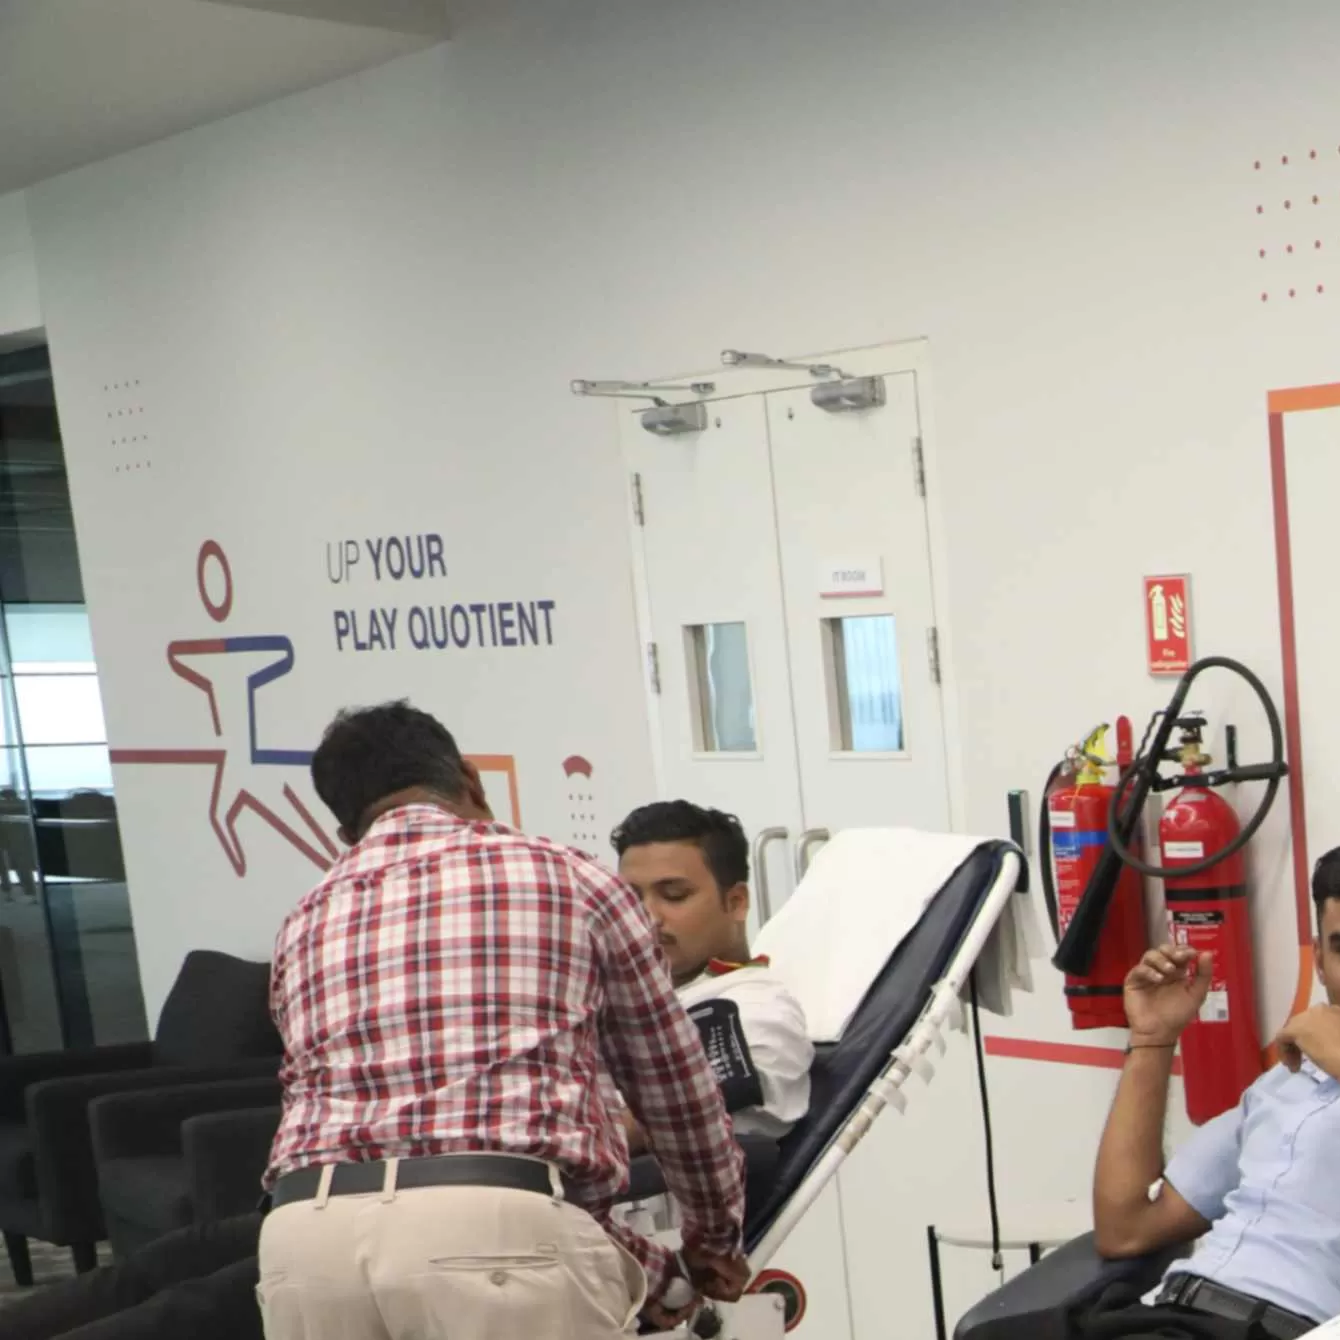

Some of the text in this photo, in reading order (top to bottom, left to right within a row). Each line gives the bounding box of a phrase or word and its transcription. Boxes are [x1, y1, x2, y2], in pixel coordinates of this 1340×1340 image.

[326, 533, 447, 584] UP YOUR
[333, 600, 555, 651] PLAY QUOTIENT
